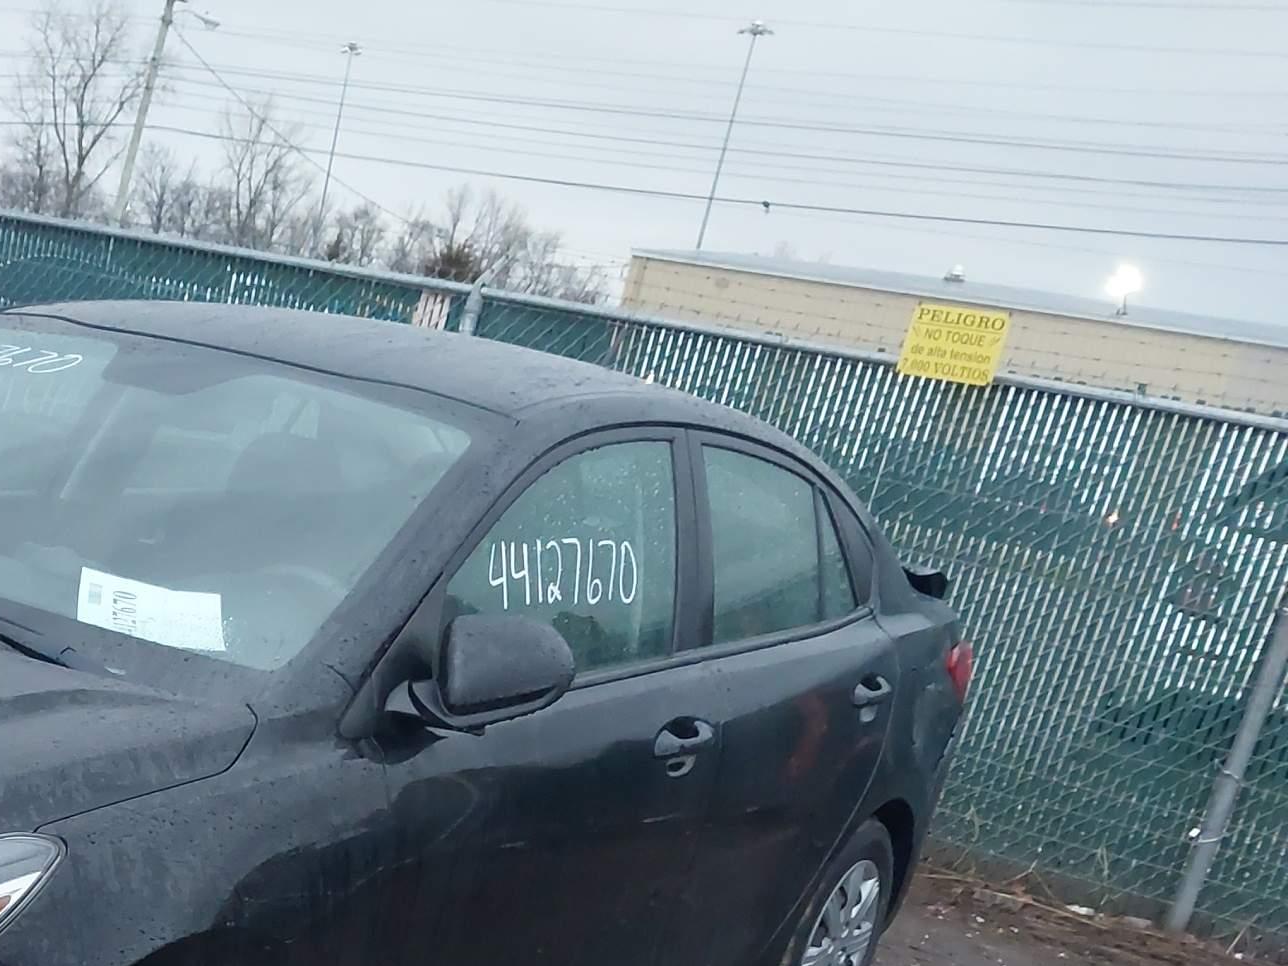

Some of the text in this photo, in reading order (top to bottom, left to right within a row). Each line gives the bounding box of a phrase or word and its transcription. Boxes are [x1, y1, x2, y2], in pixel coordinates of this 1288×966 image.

[918, 307, 1006, 331] PELIGRO
[924, 327, 986, 347] NO TOQUE
[911, 343, 925, 355] de
[927, 345, 948, 358] alta
[934, 361, 991, 381] VOLTIOS
[488, 538, 638, 611] 44127670
